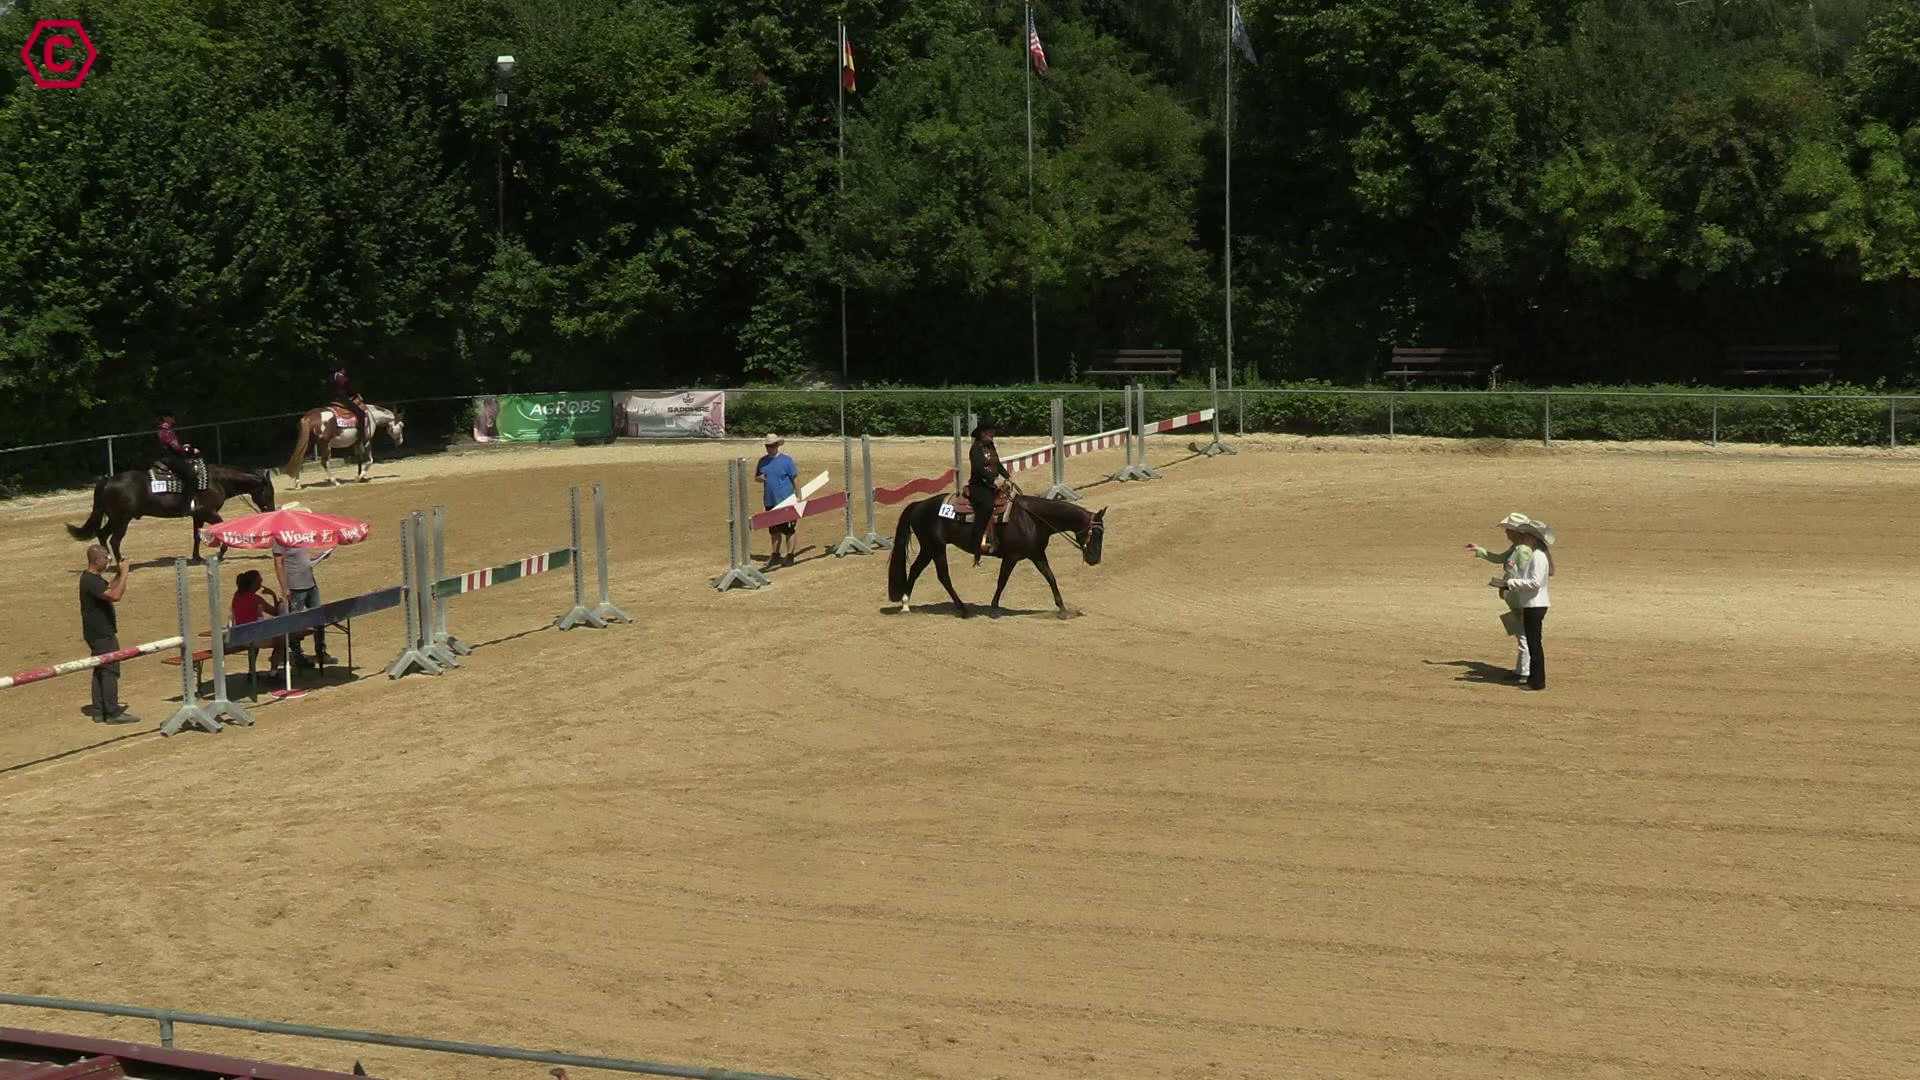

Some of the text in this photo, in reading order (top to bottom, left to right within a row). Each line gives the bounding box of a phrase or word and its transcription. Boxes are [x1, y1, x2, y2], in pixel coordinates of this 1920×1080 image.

[529, 400, 601, 417] AGROBS
[222, 531, 256, 544] West
[280, 530, 315, 543] West
